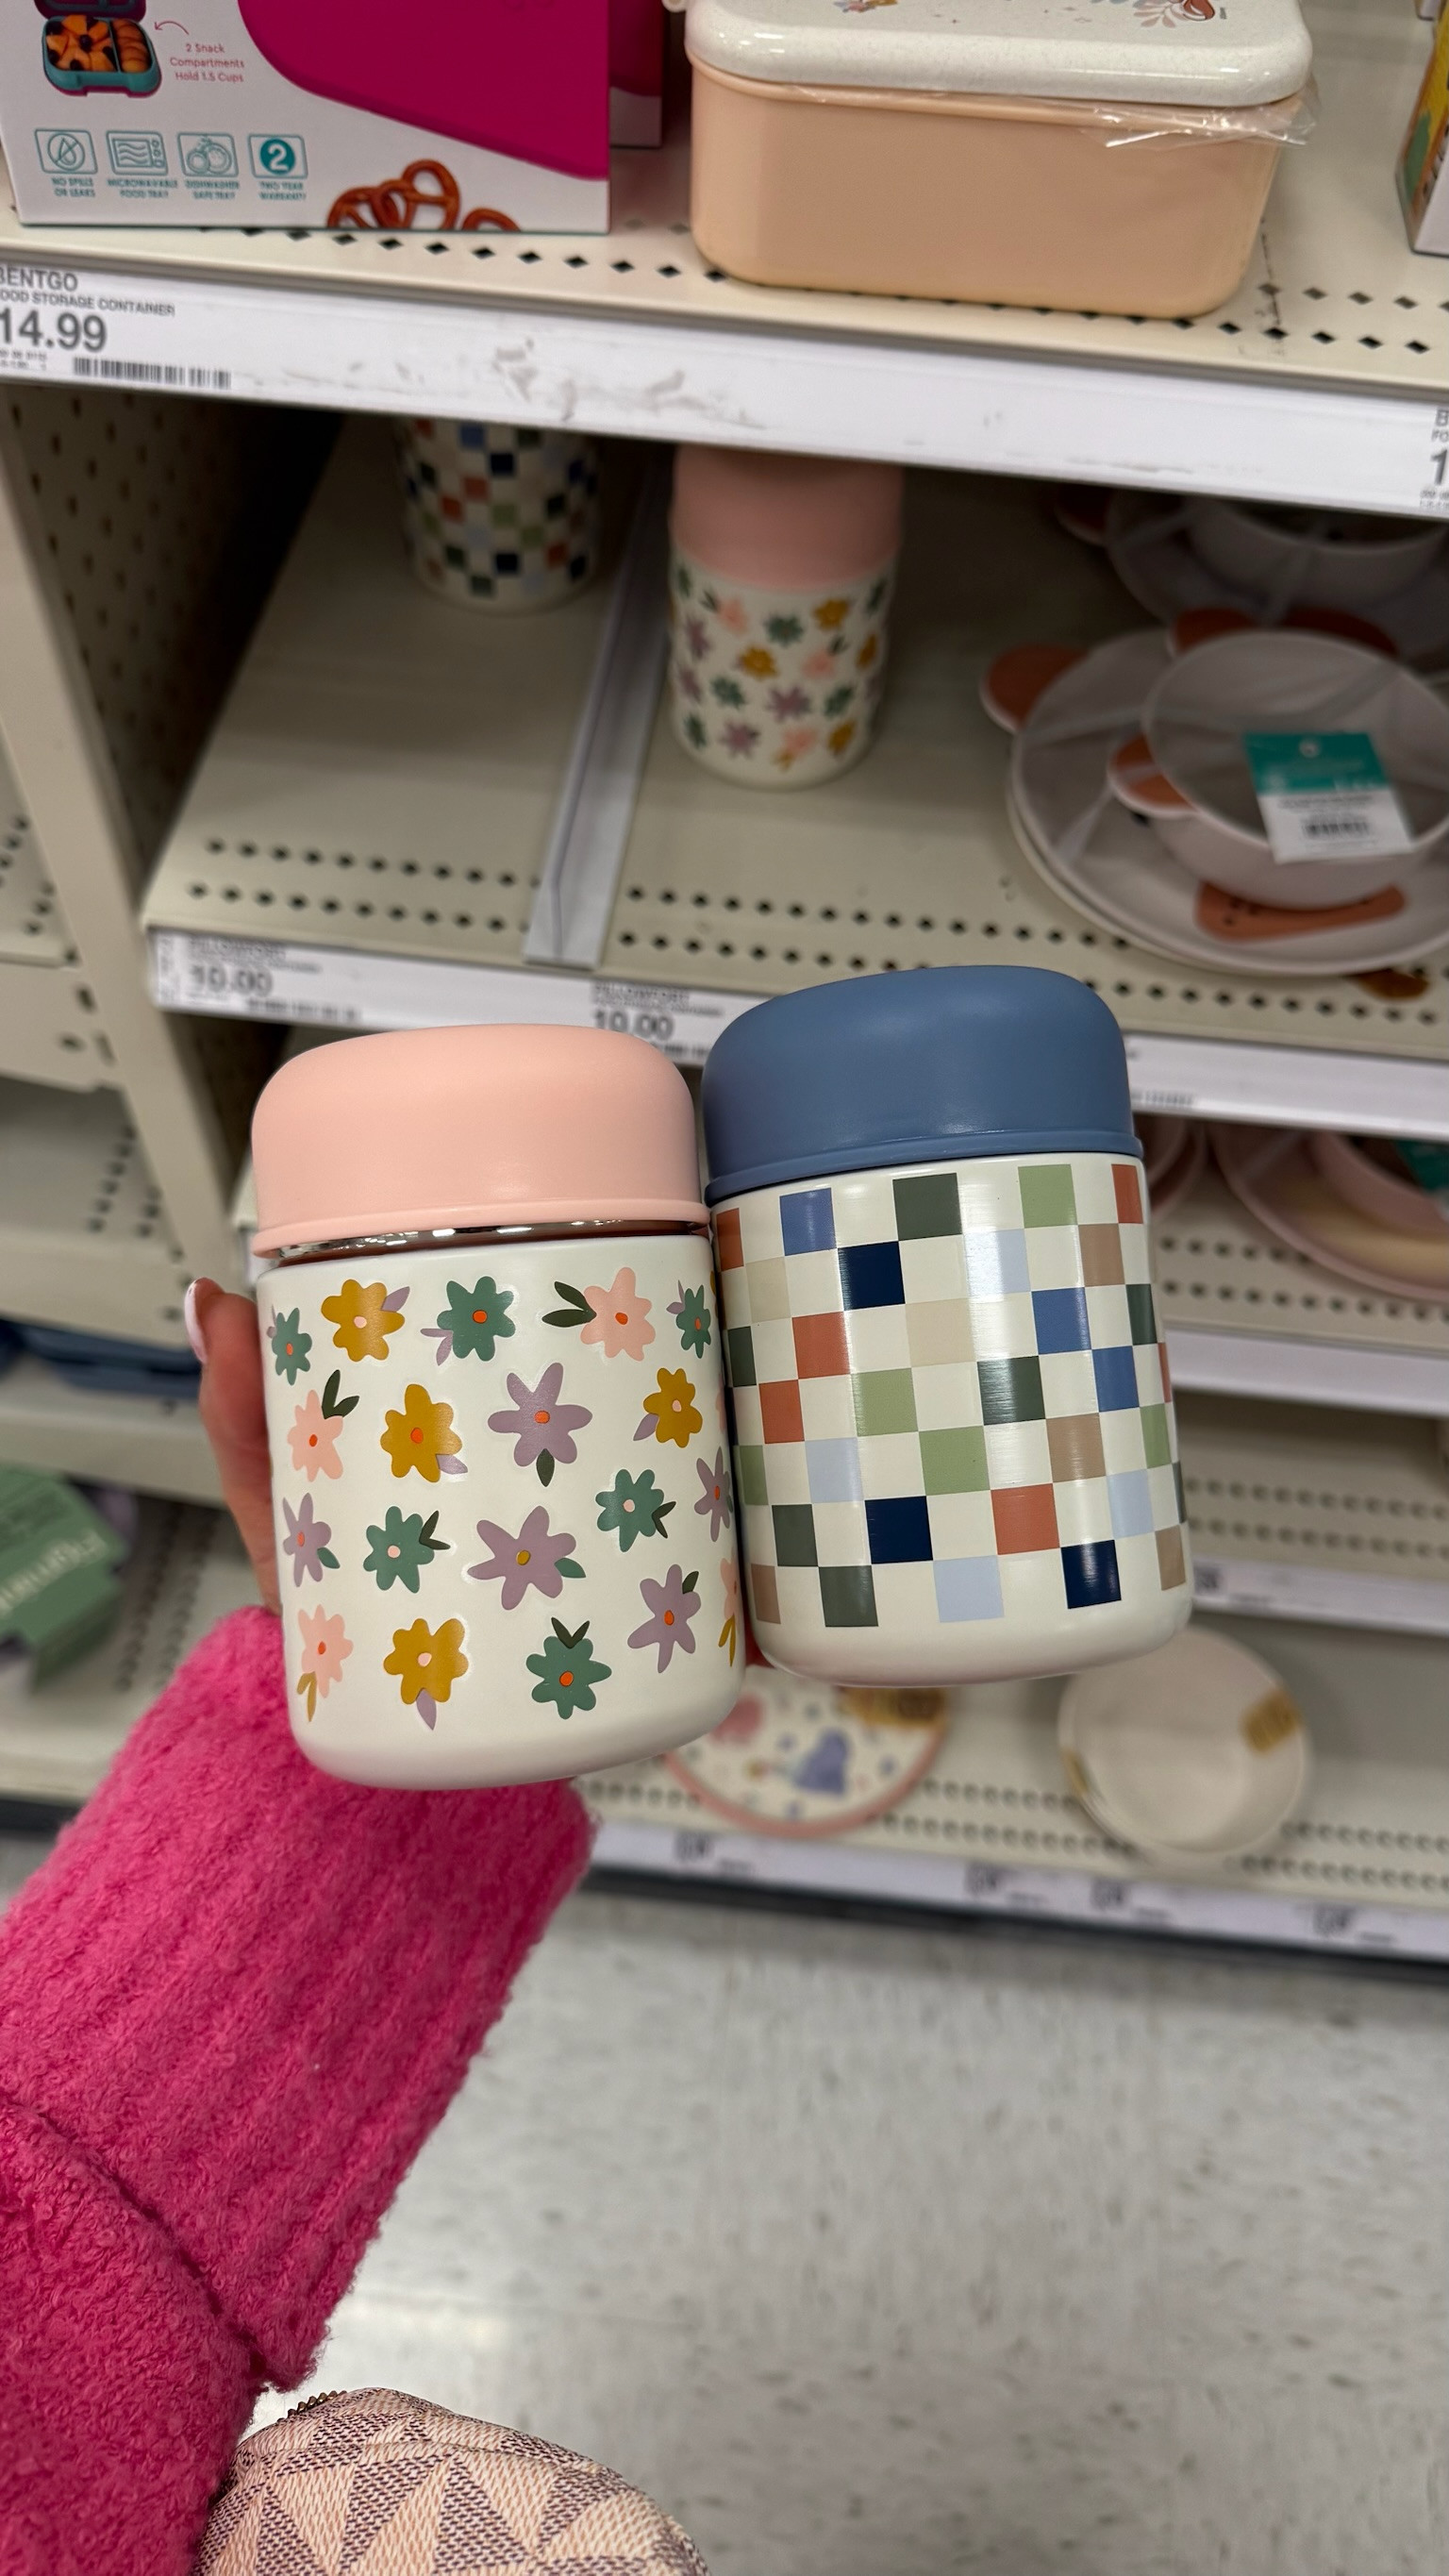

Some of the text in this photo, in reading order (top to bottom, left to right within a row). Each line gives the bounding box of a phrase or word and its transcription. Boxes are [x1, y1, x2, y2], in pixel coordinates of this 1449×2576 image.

[186, 43, 225, 54] 2 Snack
[170, 57, 244, 69] Compartments
[175, 71, 244, 83] Hold 1.5 Cups
[0, 289, 175, 317] OOD STORAGE CONTAINER
[0, 307, 108, 353] 14.99
